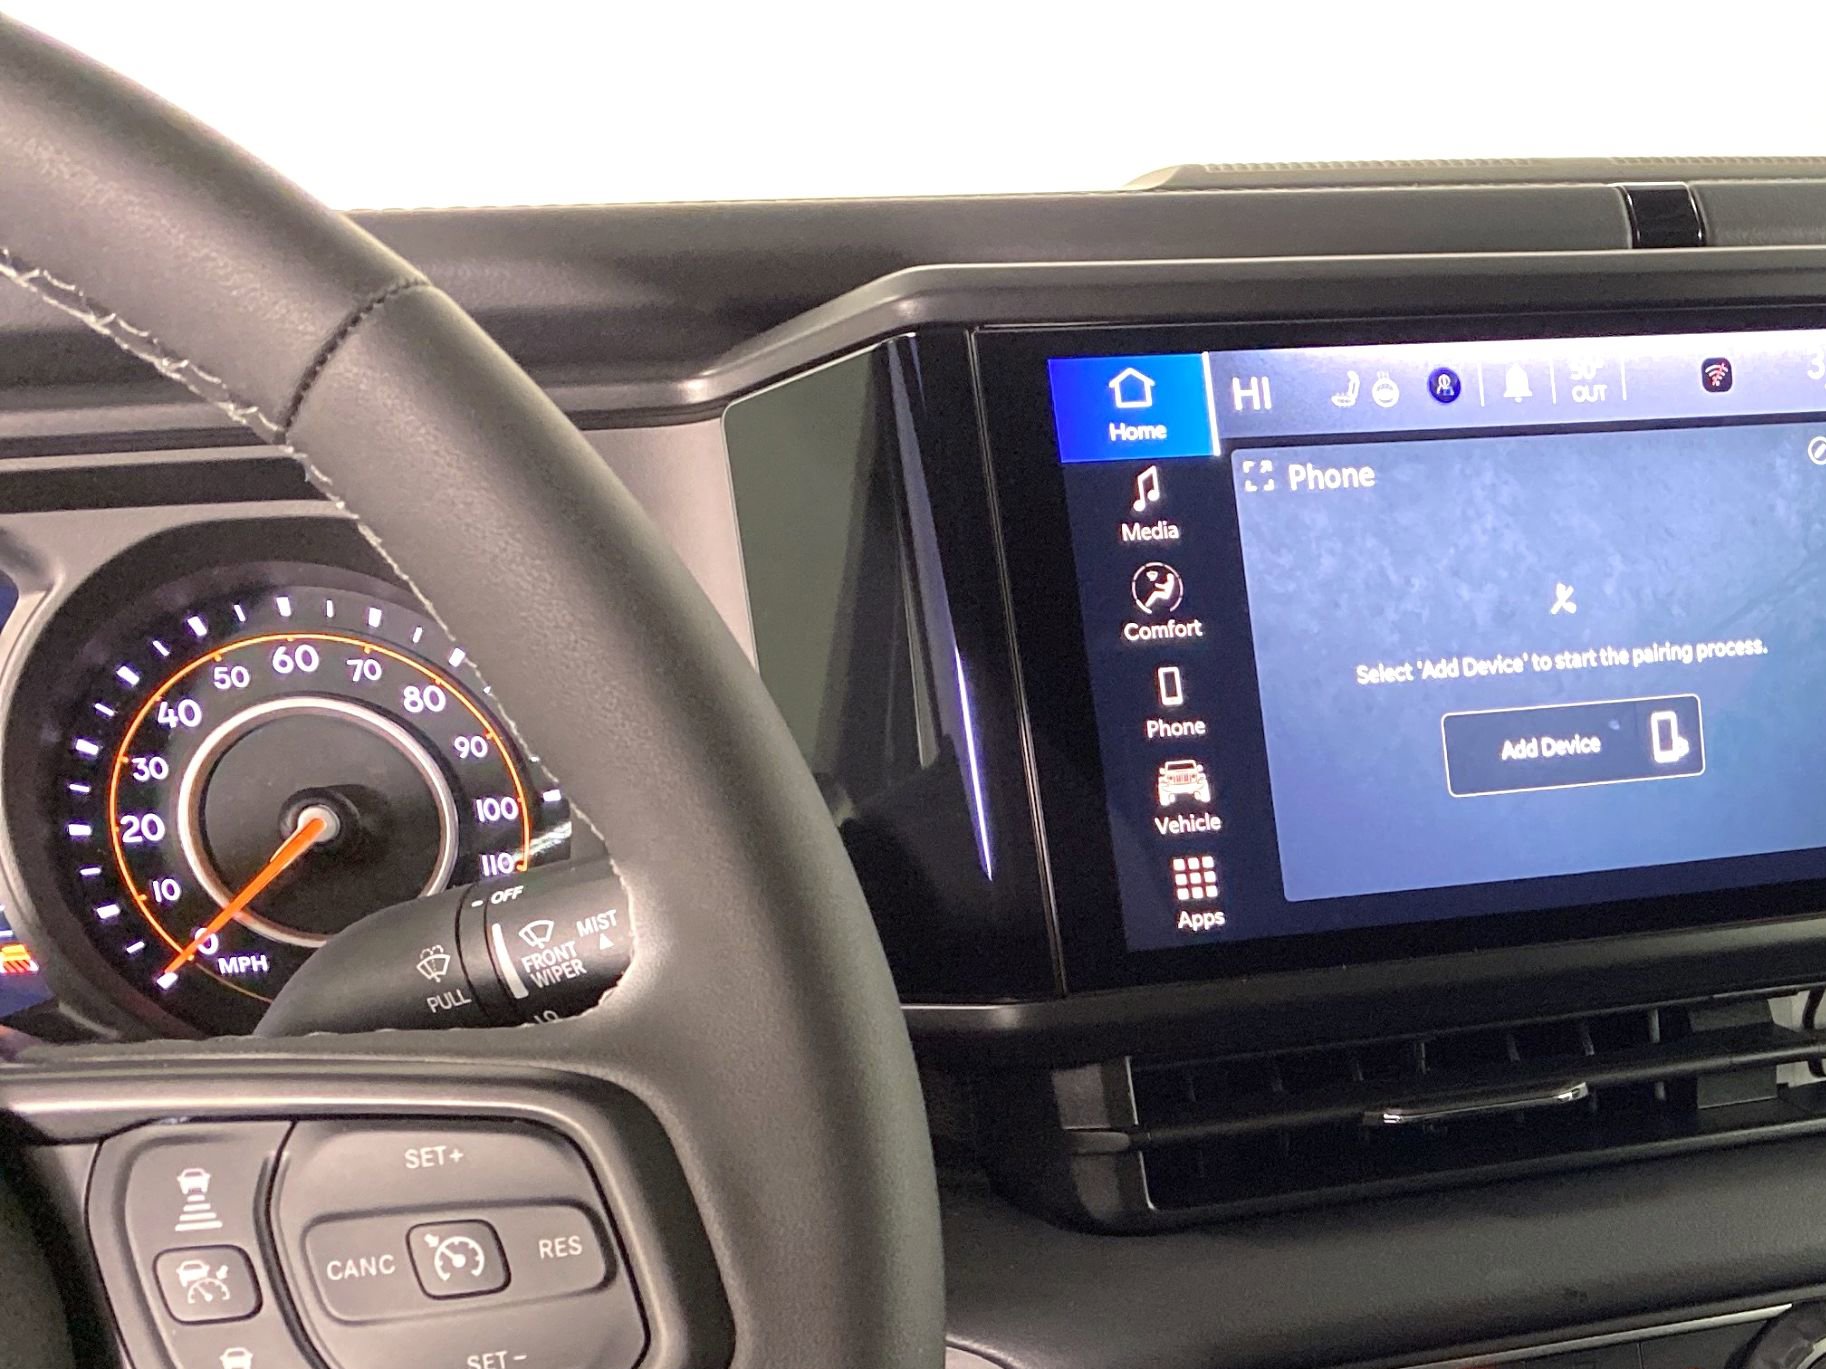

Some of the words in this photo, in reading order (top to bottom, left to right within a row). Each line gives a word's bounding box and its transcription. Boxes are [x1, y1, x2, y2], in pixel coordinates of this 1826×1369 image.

[1232, 376, 1273, 410] HI
[1571, 384, 1608, 403] OUT
[1108, 422, 1168, 442] Home
[1288, 462, 1376, 492] Phone
[1121, 520, 1180, 542] Media
[1123, 618, 1204, 641] Comfort
[272, 644, 320, 674] 60
[347, 658, 383, 682] 70
[1356, 659, 1414, 685] Select
[1417, 656, 1459, 680] 'Add
[1463, 651, 1529, 678] Device'
[1532, 653, 1553, 672] to
[1555, 648, 1597, 671] start
[1599, 645, 1629, 668] the
[1633, 642, 1694, 668] pairing
[1697, 637, 1769, 664] process.
[213, 665, 251, 690] 50
[402, 684, 446, 713] 80
[157, 698, 202, 728] 40
[1146, 719, 1207, 739] Phone
[453, 735, 488, 758] 90
[1501, 739, 1538, 761] Add
[1542, 733, 1601, 759] Device
[132, 756, 169, 781] 30
[476, 797, 519, 822] 100
[121, 813, 165, 843] 20
[1154, 811, 1222, 836] Vehicle
[480, 852, 515, 876] 110
[152, 878, 181, 903] 10
[490, 885, 524, 905] OFF
[576, 909, 618, 937] MIST
[1177, 909, 1226, 932] Apps
[194, 927, 219, 955] 0
[217, 954, 269, 975] MPH
[520, 941, 578, 973] FRONT
[529, 959, 588, 989] WIPER
[426, 989, 472, 1014] PULL
[404, 1146, 464, 1170] SET+
[538, 1235, 583, 1260] RES
[326, 1253, 396, 1281] CANC
